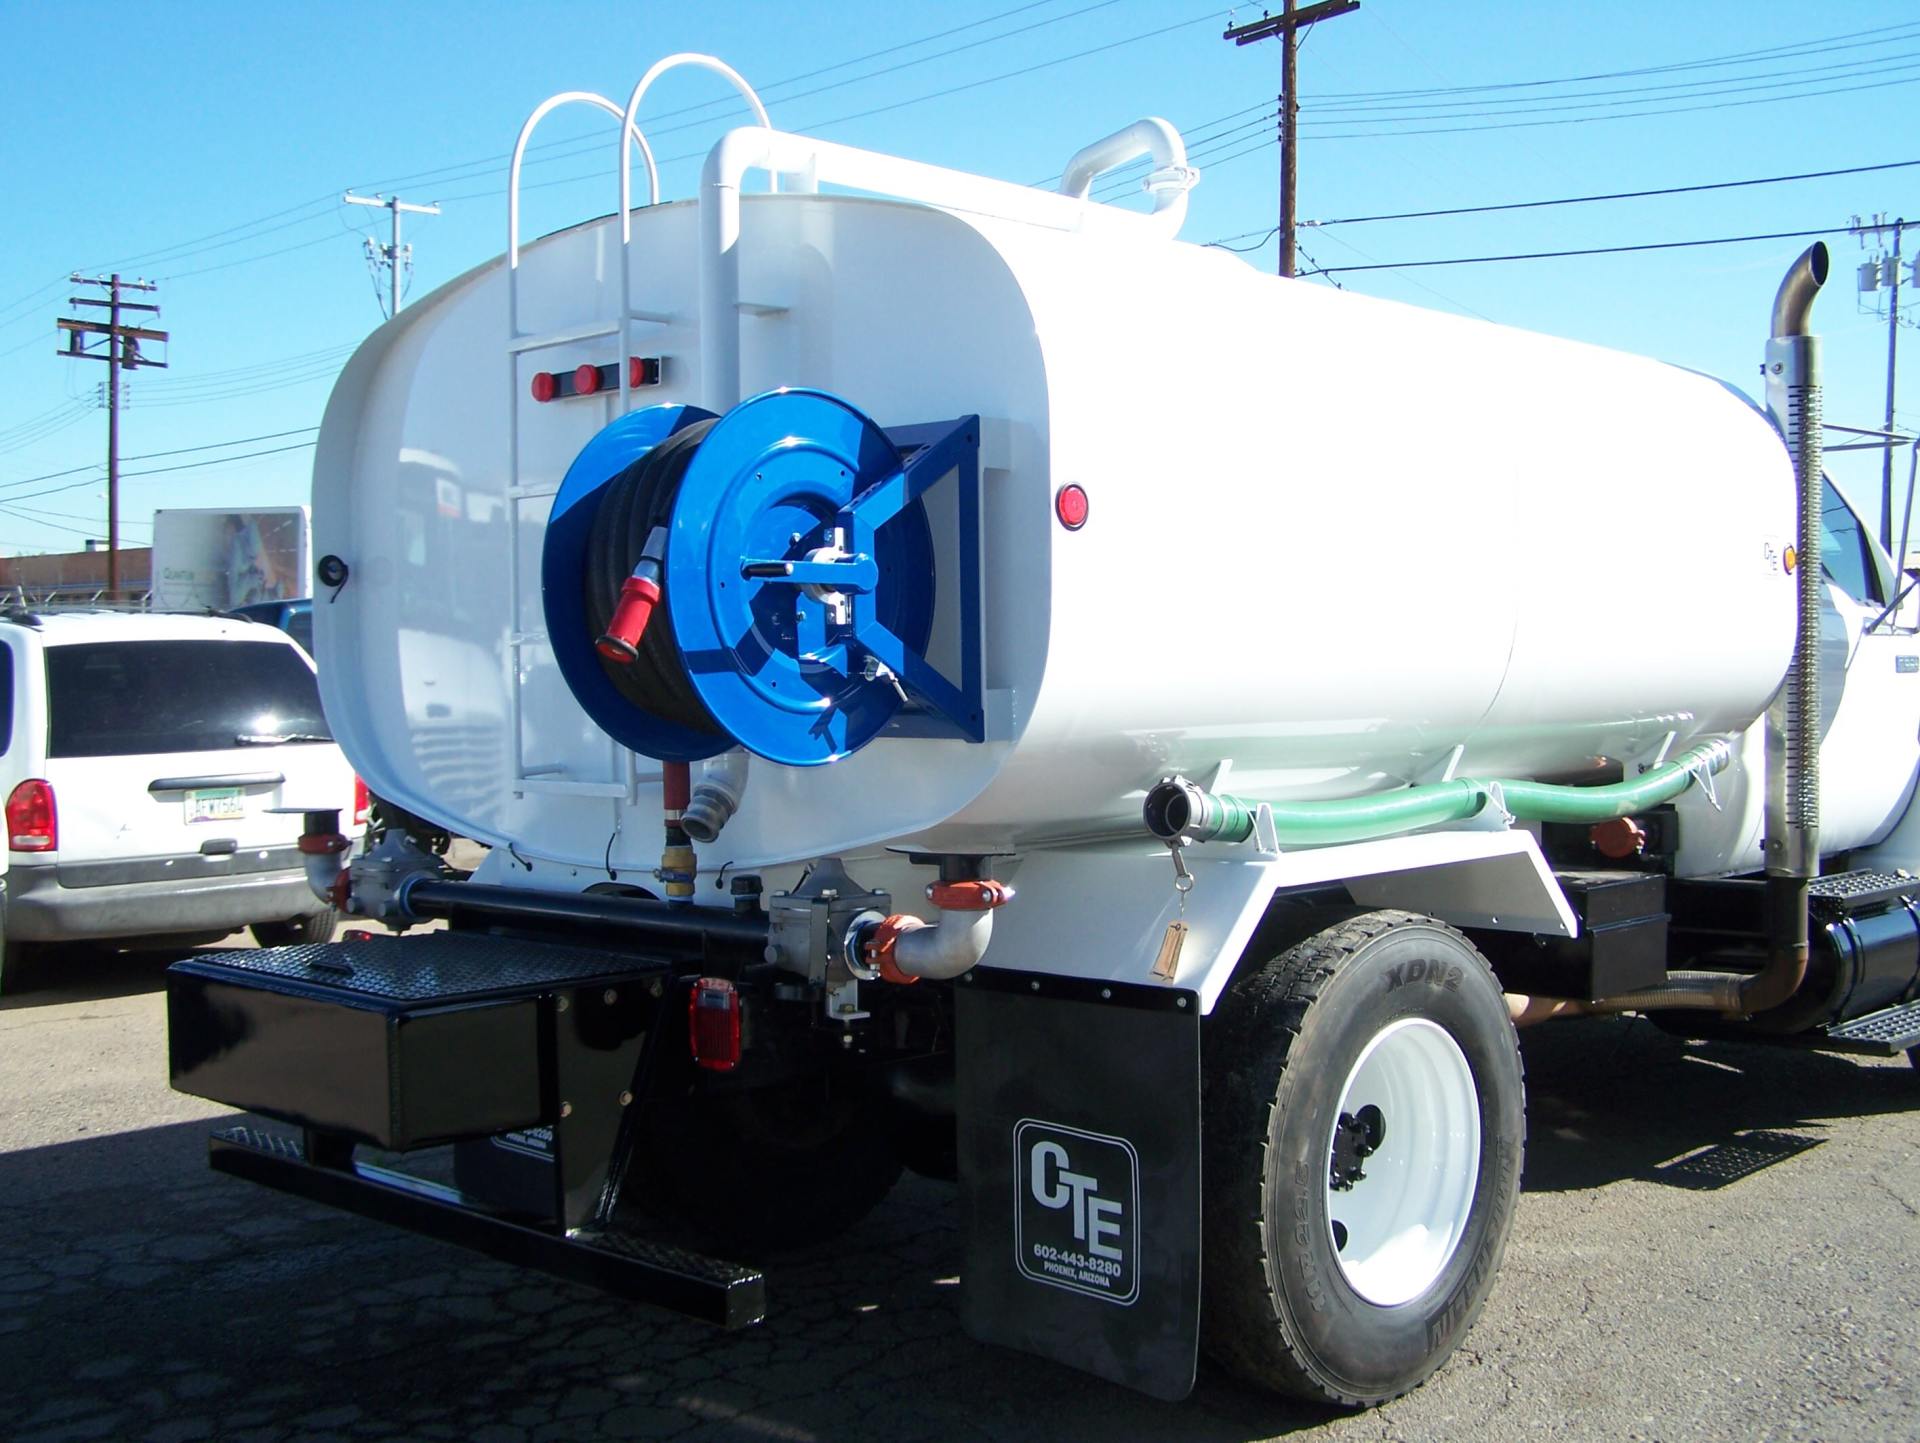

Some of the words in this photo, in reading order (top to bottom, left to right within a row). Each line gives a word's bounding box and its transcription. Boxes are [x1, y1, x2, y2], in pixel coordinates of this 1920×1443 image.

[1385, 958, 1465, 992] XDN2
[1031, 1140, 1122, 1261] CTE
[1033, 1243, 1122, 1277] 602-443-8280
[1043, 1260, 1078, 1280] PHOENIX,
[1078, 1269, 1111, 1288] ARIZONA
